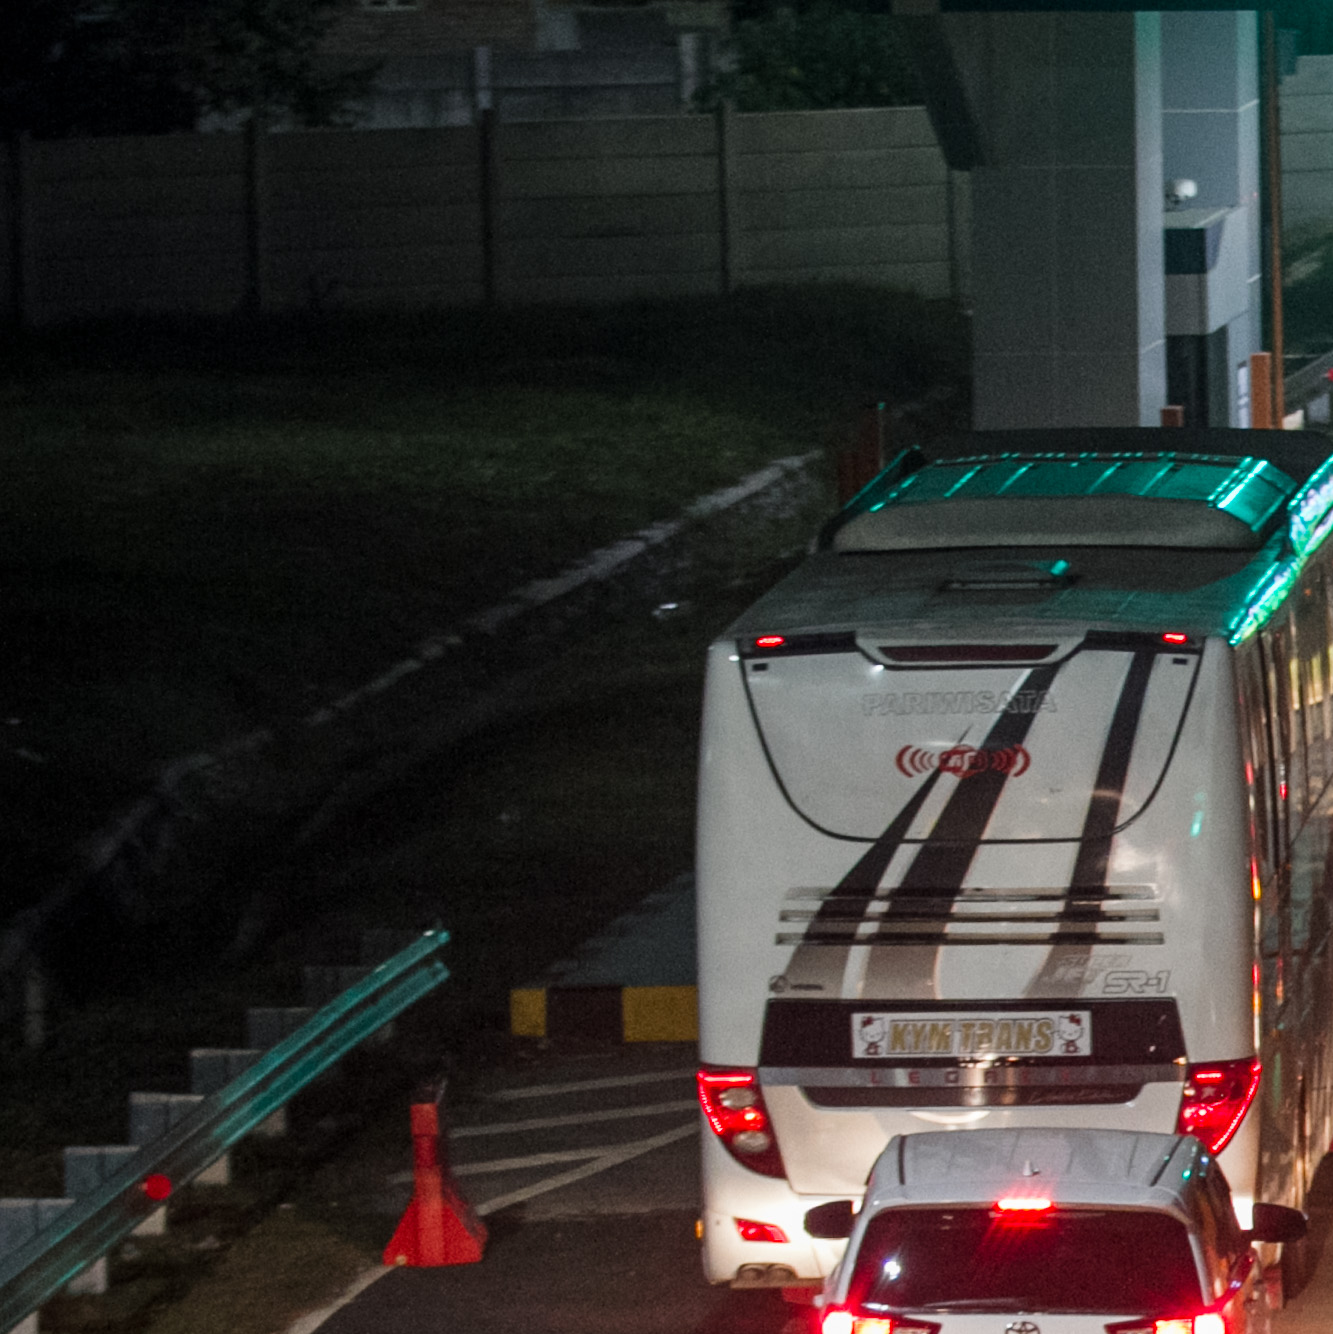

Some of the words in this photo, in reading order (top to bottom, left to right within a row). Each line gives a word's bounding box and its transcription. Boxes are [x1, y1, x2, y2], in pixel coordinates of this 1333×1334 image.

[862, 690, 1059, 716] PARIWISATA
[1102, 970, 1171, 995] SR-1
[886, 1019, 952, 1056] KYM
[960, 1018, 1055, 1054] TRANS
